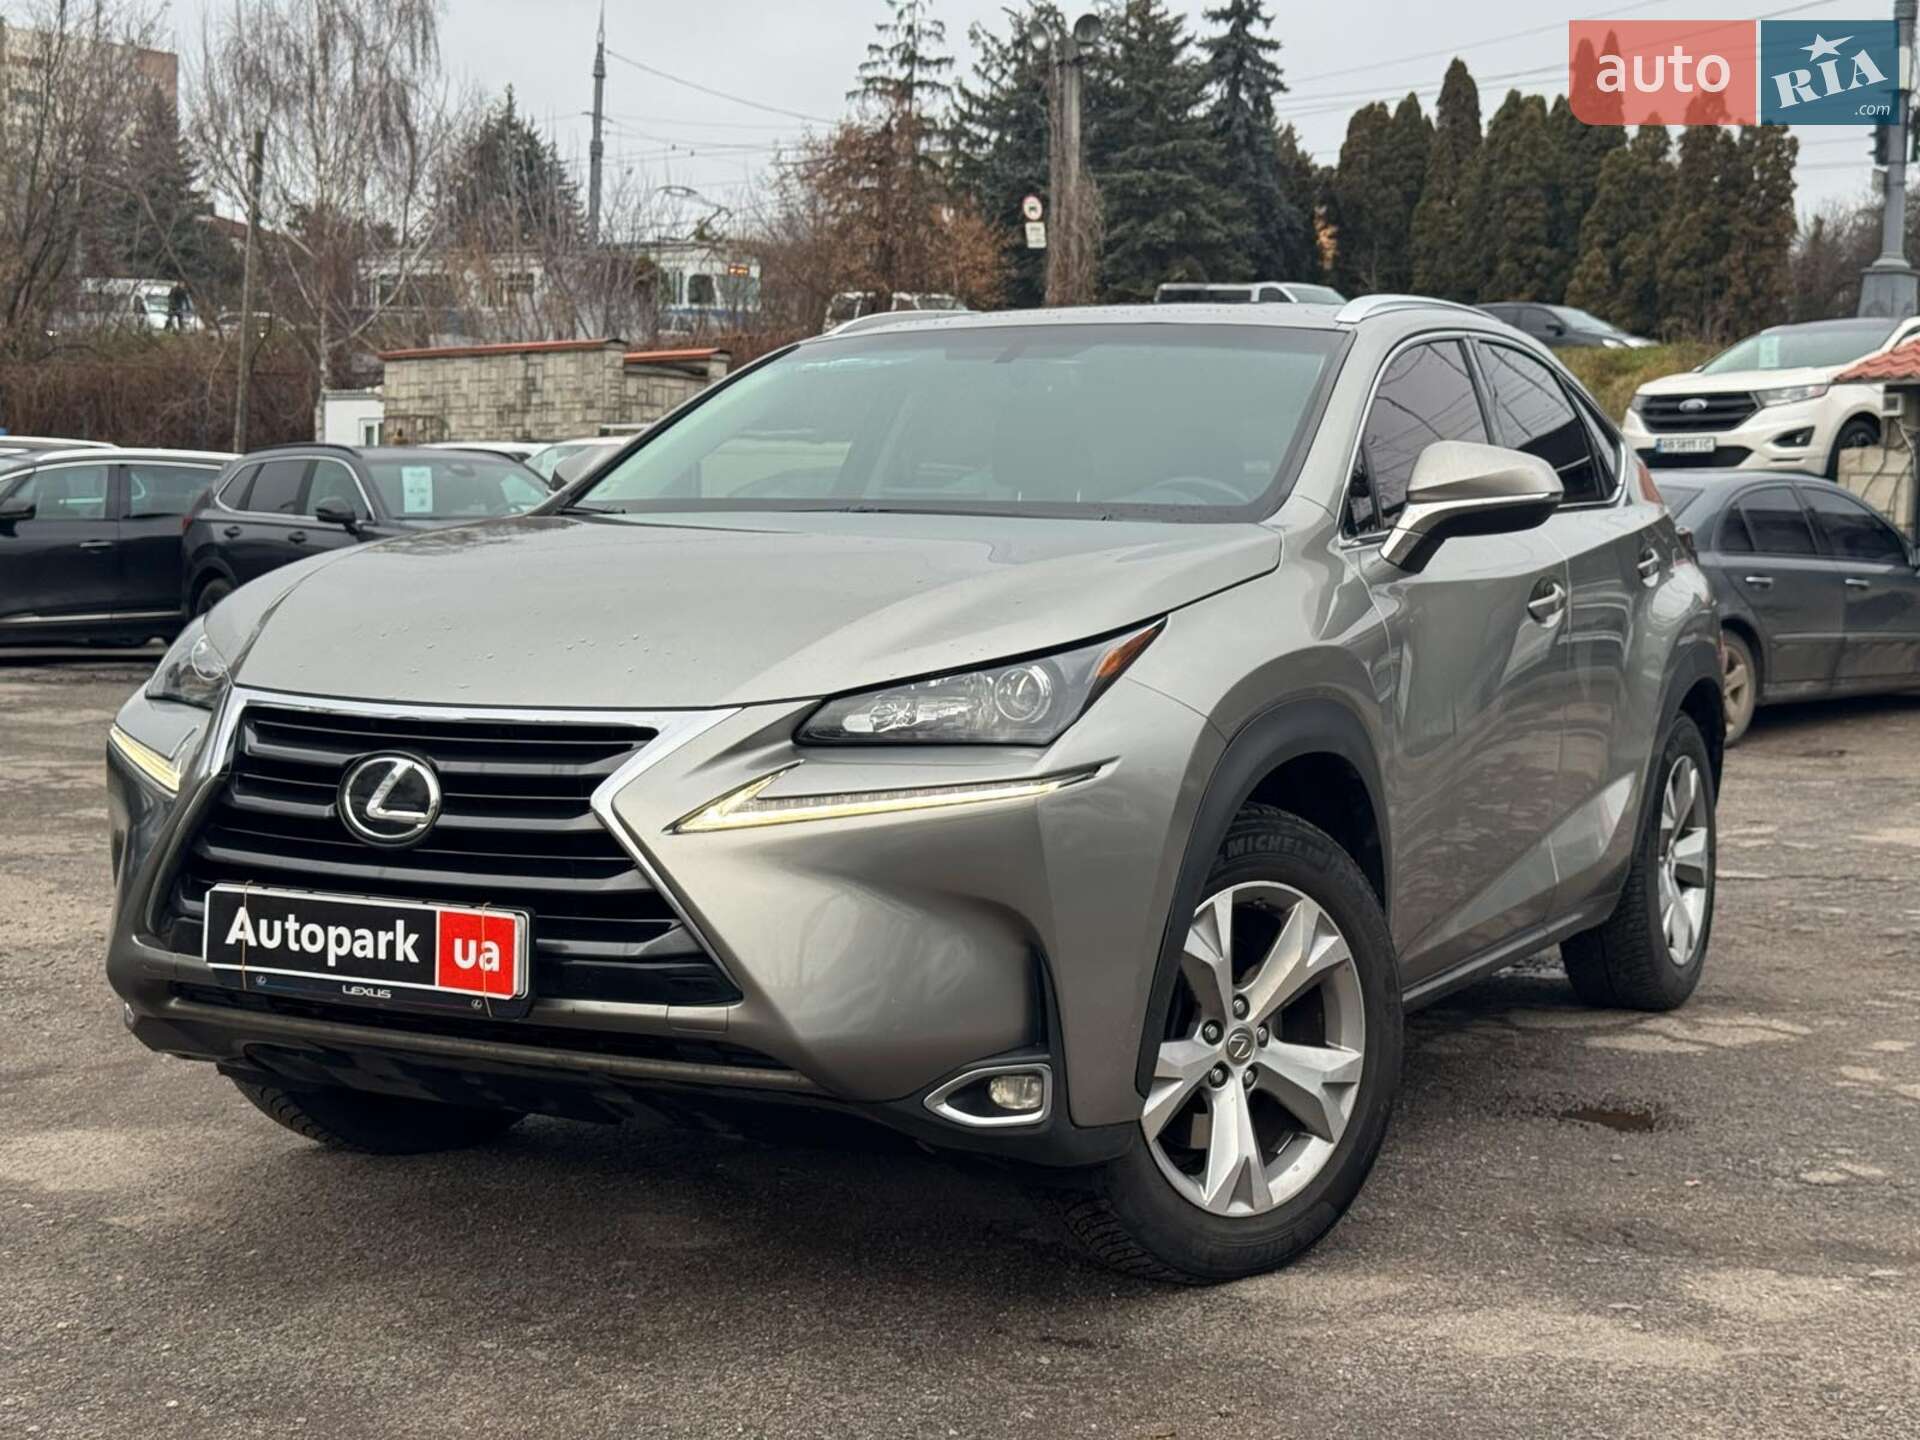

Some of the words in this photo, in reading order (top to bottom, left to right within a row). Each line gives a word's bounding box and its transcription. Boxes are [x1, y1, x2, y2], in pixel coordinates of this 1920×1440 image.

[224, 906, 420, 967] Autopark
[453, 936, 501, 972] ua
[342, 984, 392, 999] LEXUS
